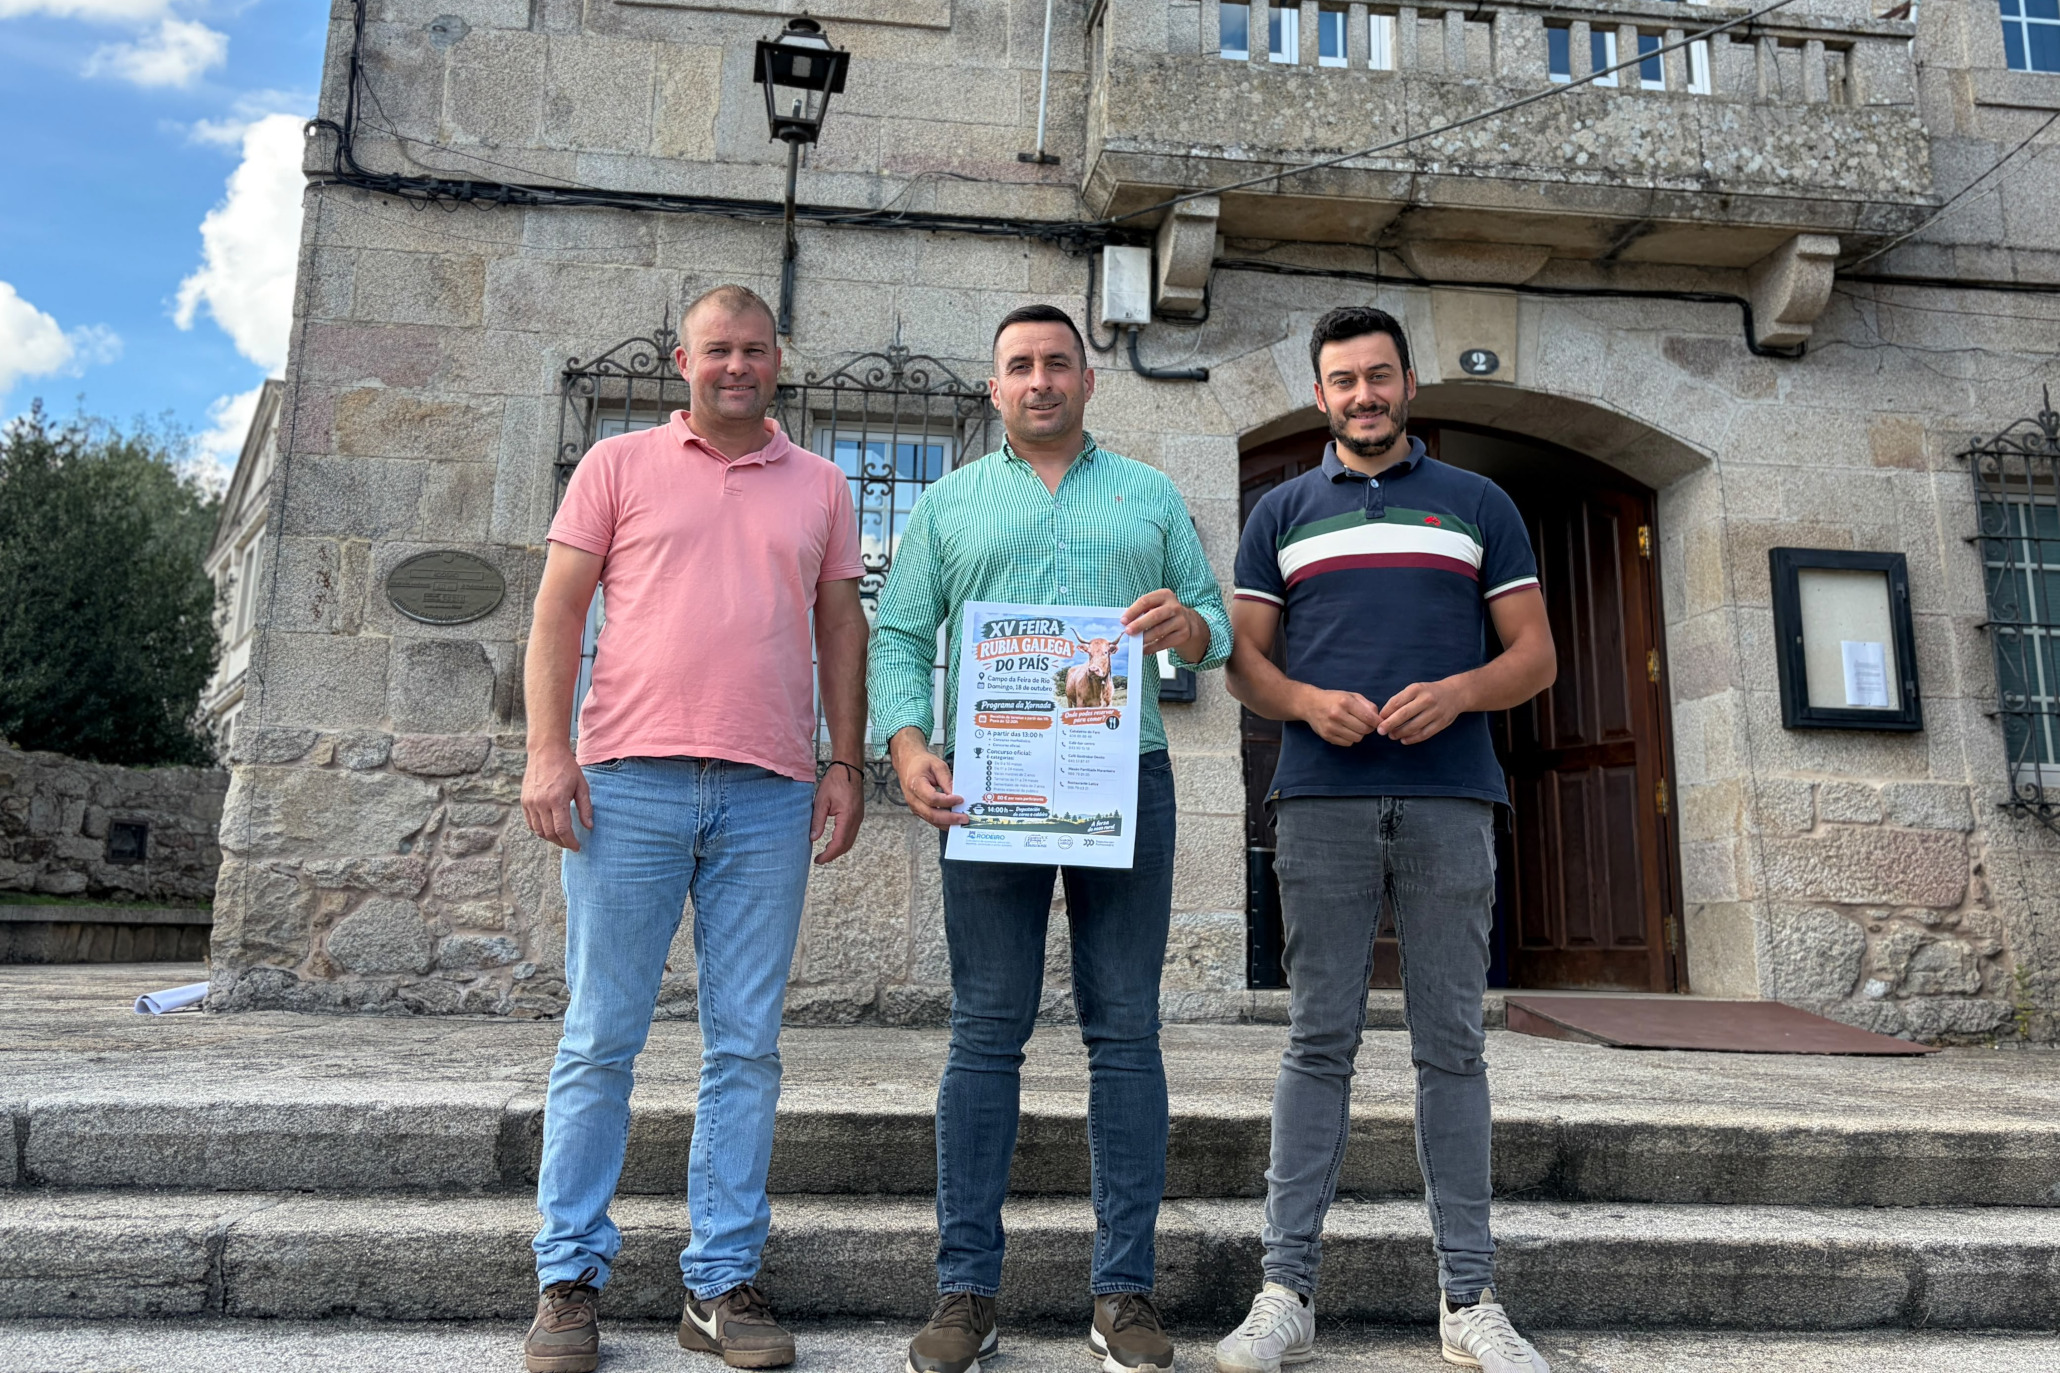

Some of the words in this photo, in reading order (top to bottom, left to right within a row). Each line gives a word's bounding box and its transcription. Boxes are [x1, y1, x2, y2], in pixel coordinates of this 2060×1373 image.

[1472, 352, 1486, 371] 2
[989, 620, 1016, 637] XV
[1018, 620, 1060, 635] FEIRA
[980, 638, 1020, 658] RUBIA
[1022, 638, 1072, 657] GALEGA
[994, 658, 1014, 672] DO
[1018, 654, 1050, 671] PAÍS
[988, 675, 1008, 683] Campo
[988, 683, 1015, 692] Domingo,
[981, 700, 1014, 710] Programa
[1024, 701, 1052, 710] Xornada
